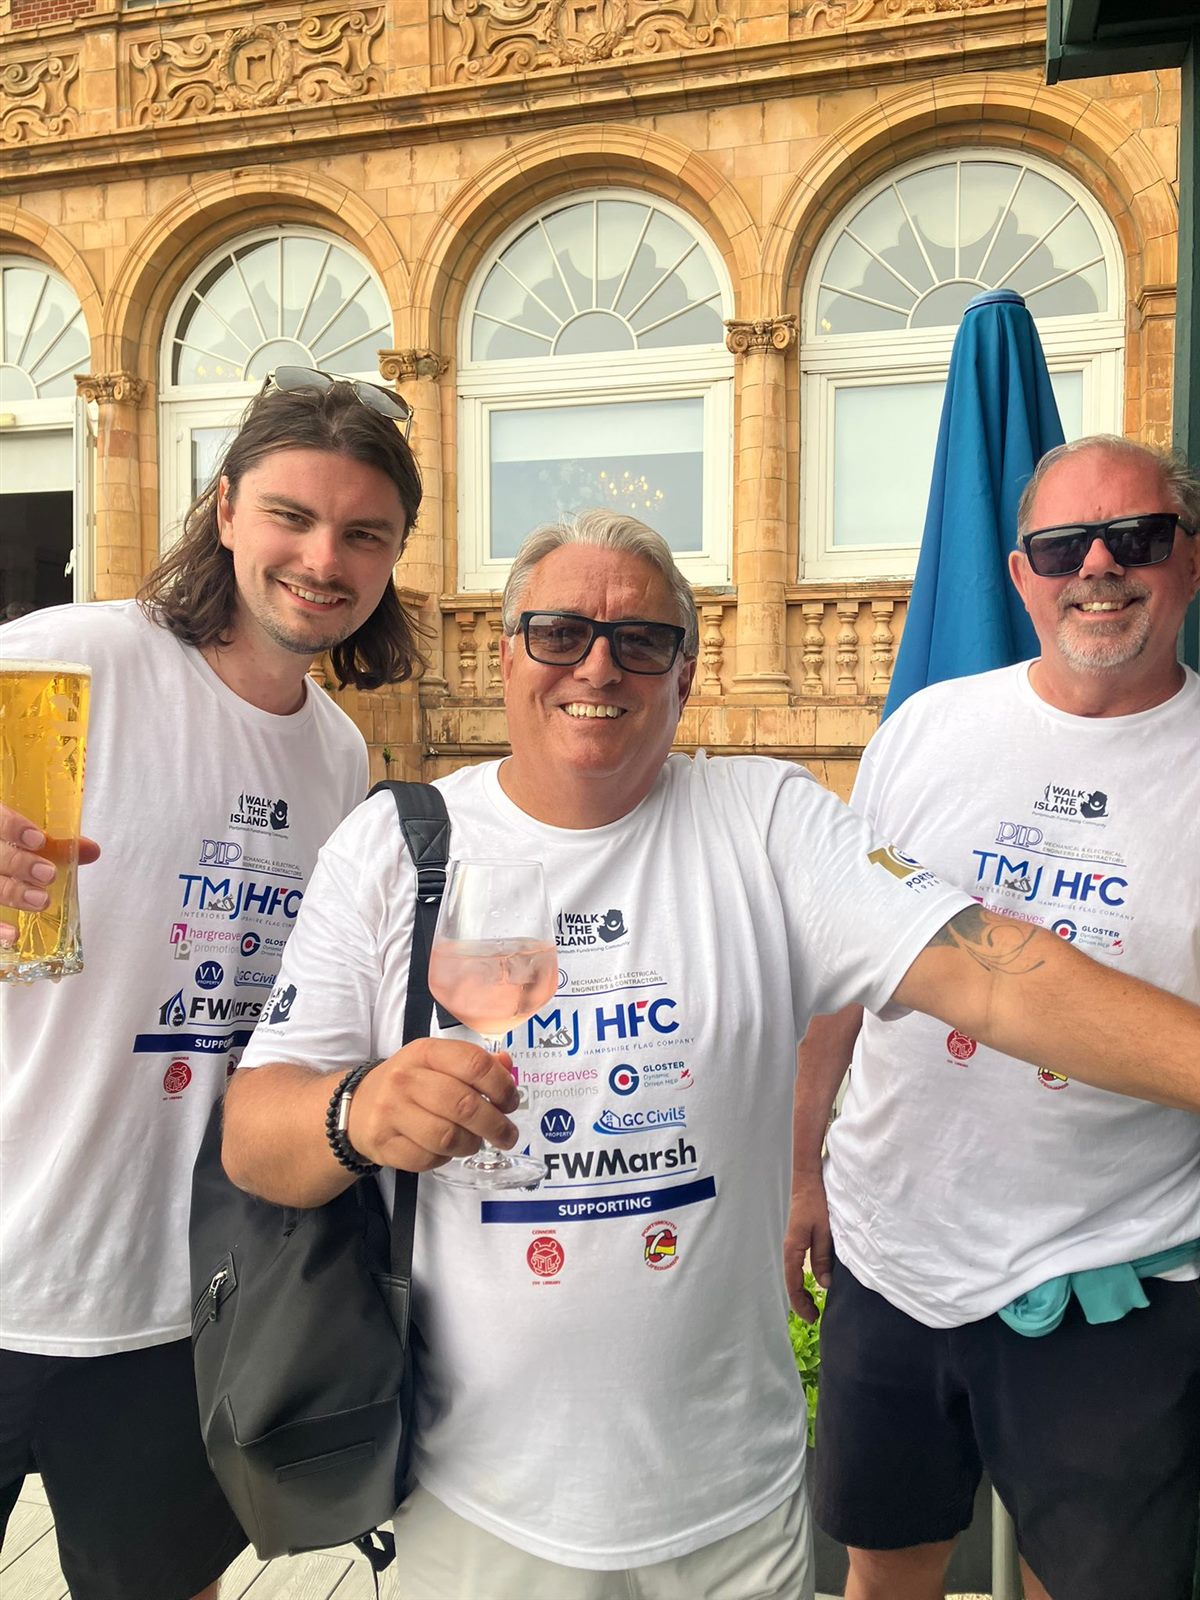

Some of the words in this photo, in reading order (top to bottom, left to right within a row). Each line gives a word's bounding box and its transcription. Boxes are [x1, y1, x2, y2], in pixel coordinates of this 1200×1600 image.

[1052, 785, 1086, 799] WALK
[246, 795, 272, 808] WALK
[1054, 795, 1077, 806] THE
[247, 805, 268, 817] THE
[1033, 801, 1078, 816] ISLAND
[230, 813, 269, 828] ISLAND
[976, 885, 1022, 899] INTERIORS
[1052, 869, 1129, 906] HFC
[243, 882, 304, 919] HFC
[181, 911, 225, 920] INTERIORS
[564, 913, 599, 924] WALK
[567, 925, 592, 935] THE
[1081, 926, 1120, 938] GLOSTER
[265, 938, 286, 946] GLOST
[555, 935, 597, 946] SLAND
[252, 971, 277, 985] Civil
[571, 977, 612, 986] MECHANICAL
[619, 970, 658, 980] ELECTRICAL
[571, 984, 609, 993] ENGINEERS
[615, 976, 663, 987] CONTRACTORS
[595, 998, 680, 1042] HFC
[584, 1044, 630, 1055] HAMPSHIRE
[633, 1042, 654, 1050] FLAG
[656, 1038, 695, 1048] COMPANY
[643, 1061, 685, 1073] GLOSTER
[523, 1068, 598, 1085] hargreaves
[532, 1085, 599, 1099] promotions
[622, 1112, 644, 1126] GC
[646, 1107, 686, 1124] Civils
[544, 1138, 697, 1180] FWMarsh
[558, 1197, 652, 1217] SUPPORTING
